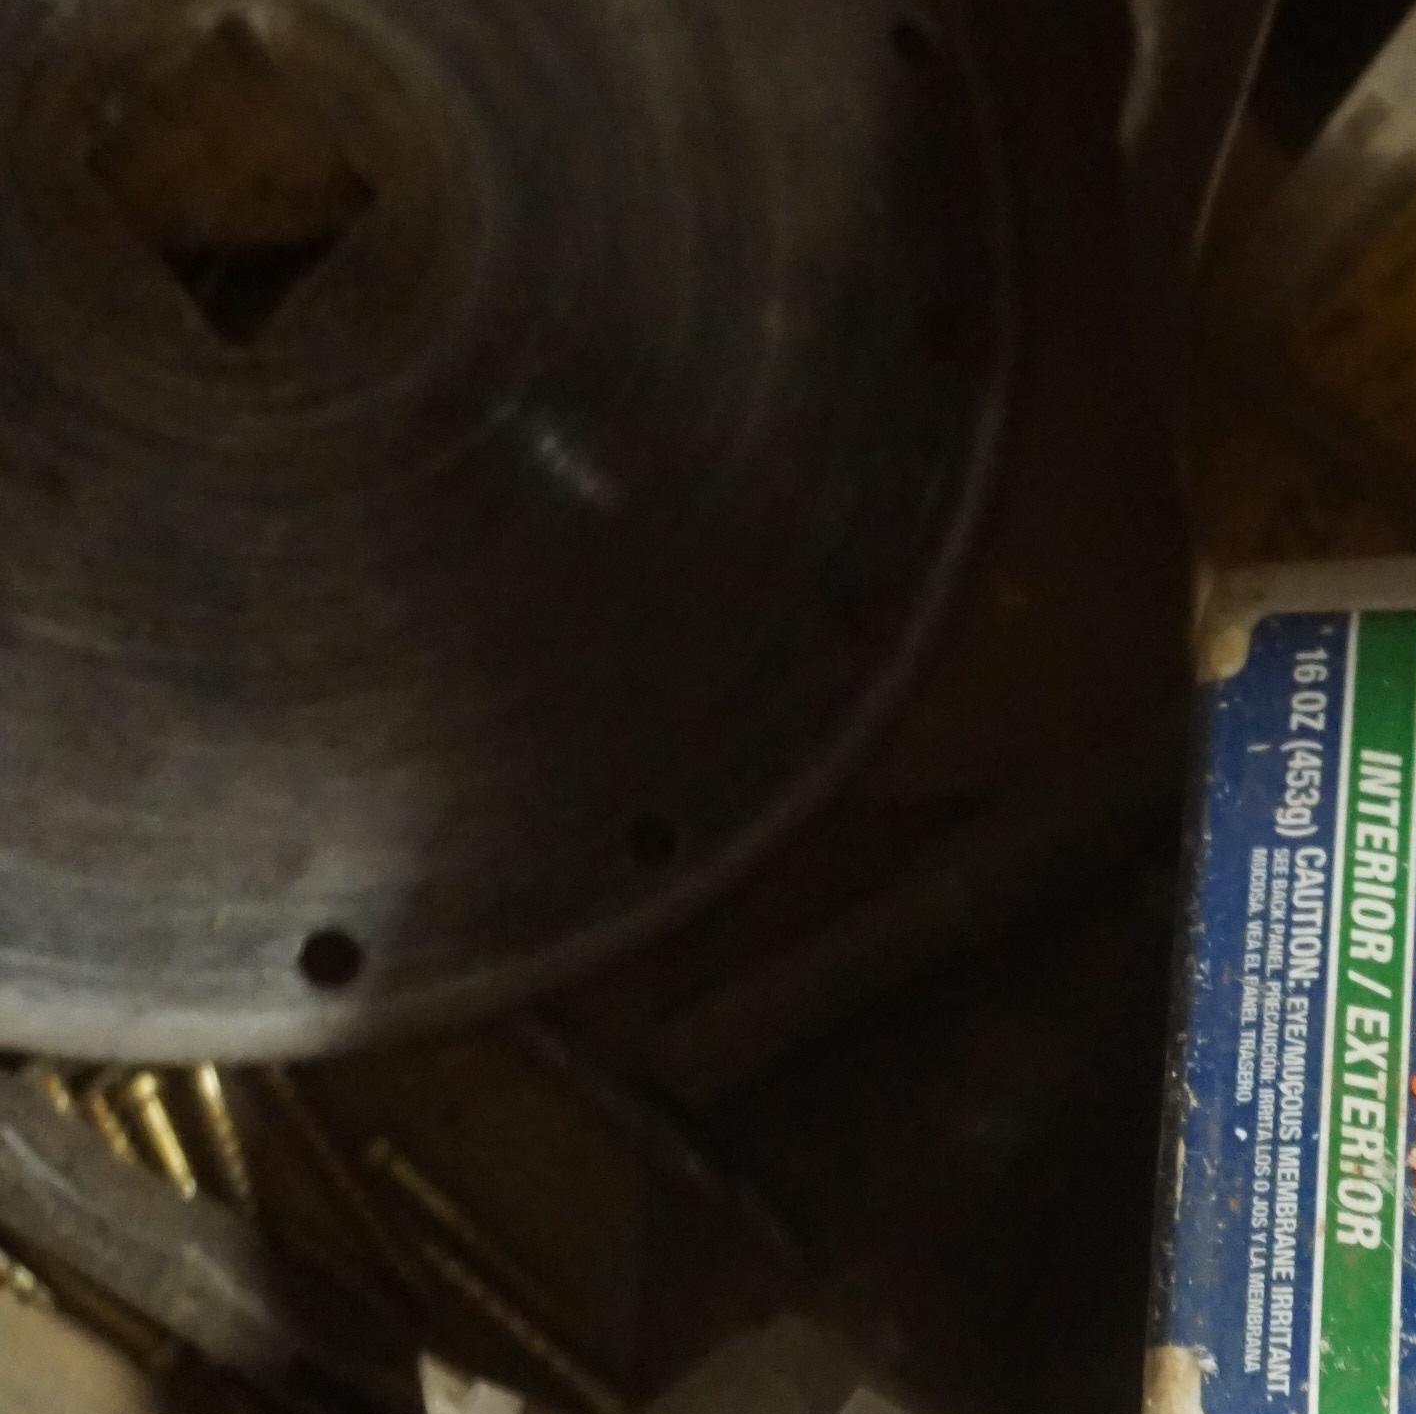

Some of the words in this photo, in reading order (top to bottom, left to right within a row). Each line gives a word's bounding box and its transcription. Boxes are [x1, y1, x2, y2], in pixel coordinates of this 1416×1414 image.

[1292, 647, 1327, 684] 16
[1288, 690, 1326, 732] OZ
[1273, 739, 1323, 837] (453g)
[1272, 848, 1289, 875] SEE
[1347, 749, 1402, 963] INTERIOR
[1248, 848, 1267, 917] MUCOSA.
[1268, 879, 1287, 920] BACK
[1245, 920, 1262, 951] VEA
[1285, 846, 1326, 988] CAUTION:
[1243, 953, 1260, 972] EL
[1346, 969, 1391, 1000] /
[1240, 975, 1258, 1026] PANEL
[1234, 1030, 1255, 1107] TRASERO.
[1276, 996, 1308, 1141] EYE/MUCOUS
[1255, 1088, 1274, 1142] IRRITA
[1334, 1005, 1389, 1250] EXTERIOR
[1253, 1145, 1270, 1177] LOS
[1250, 1195, 1268, 1228] JOS
[1270, 1145, 1300, 1280] MEMBRANE
[1248, 1247, 1265, 1269] LA
[1250, 1232, 1266, 1244] Y
[1243, 1272, 1264, 1373] MEMBRANA
[1265, 1286, 1293, 1402] IRRITANT.
